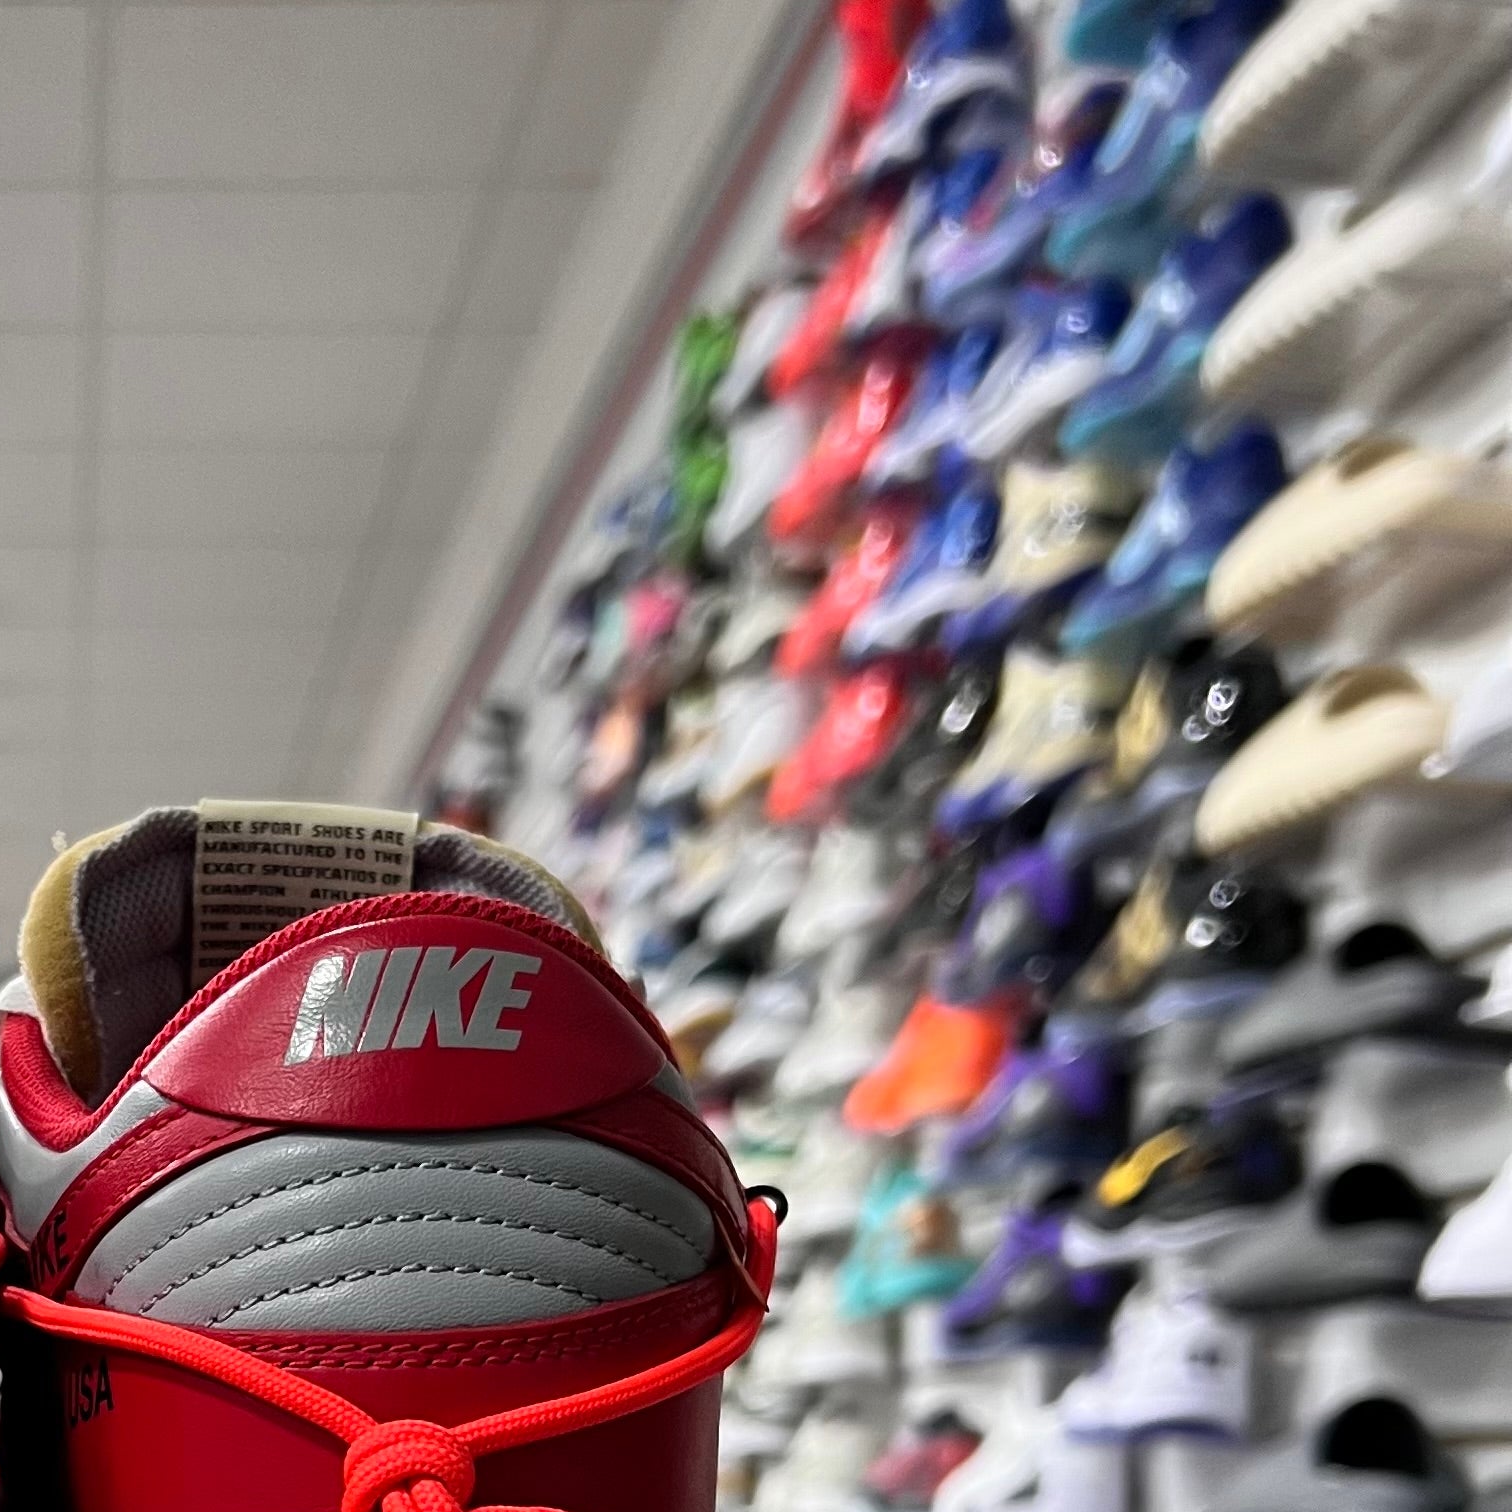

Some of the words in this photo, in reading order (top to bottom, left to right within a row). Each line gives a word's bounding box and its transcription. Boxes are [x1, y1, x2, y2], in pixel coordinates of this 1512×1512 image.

[204, 820, 243, 834] NIKE
[249, 821, 303, 836] SPORT
[311, 825, 366, 841] SHOES
[372, 829, 405, 846] ARE
[202, 841, 337, 858] MANUFACTURED
[344, 847, 366, 861] TO
[374, 850, 403, 866] THE
[202, 862, 255, 876] EXACT
[381, 873, 403, 886] OF
[283, 946, 543, 1066] NIKE
